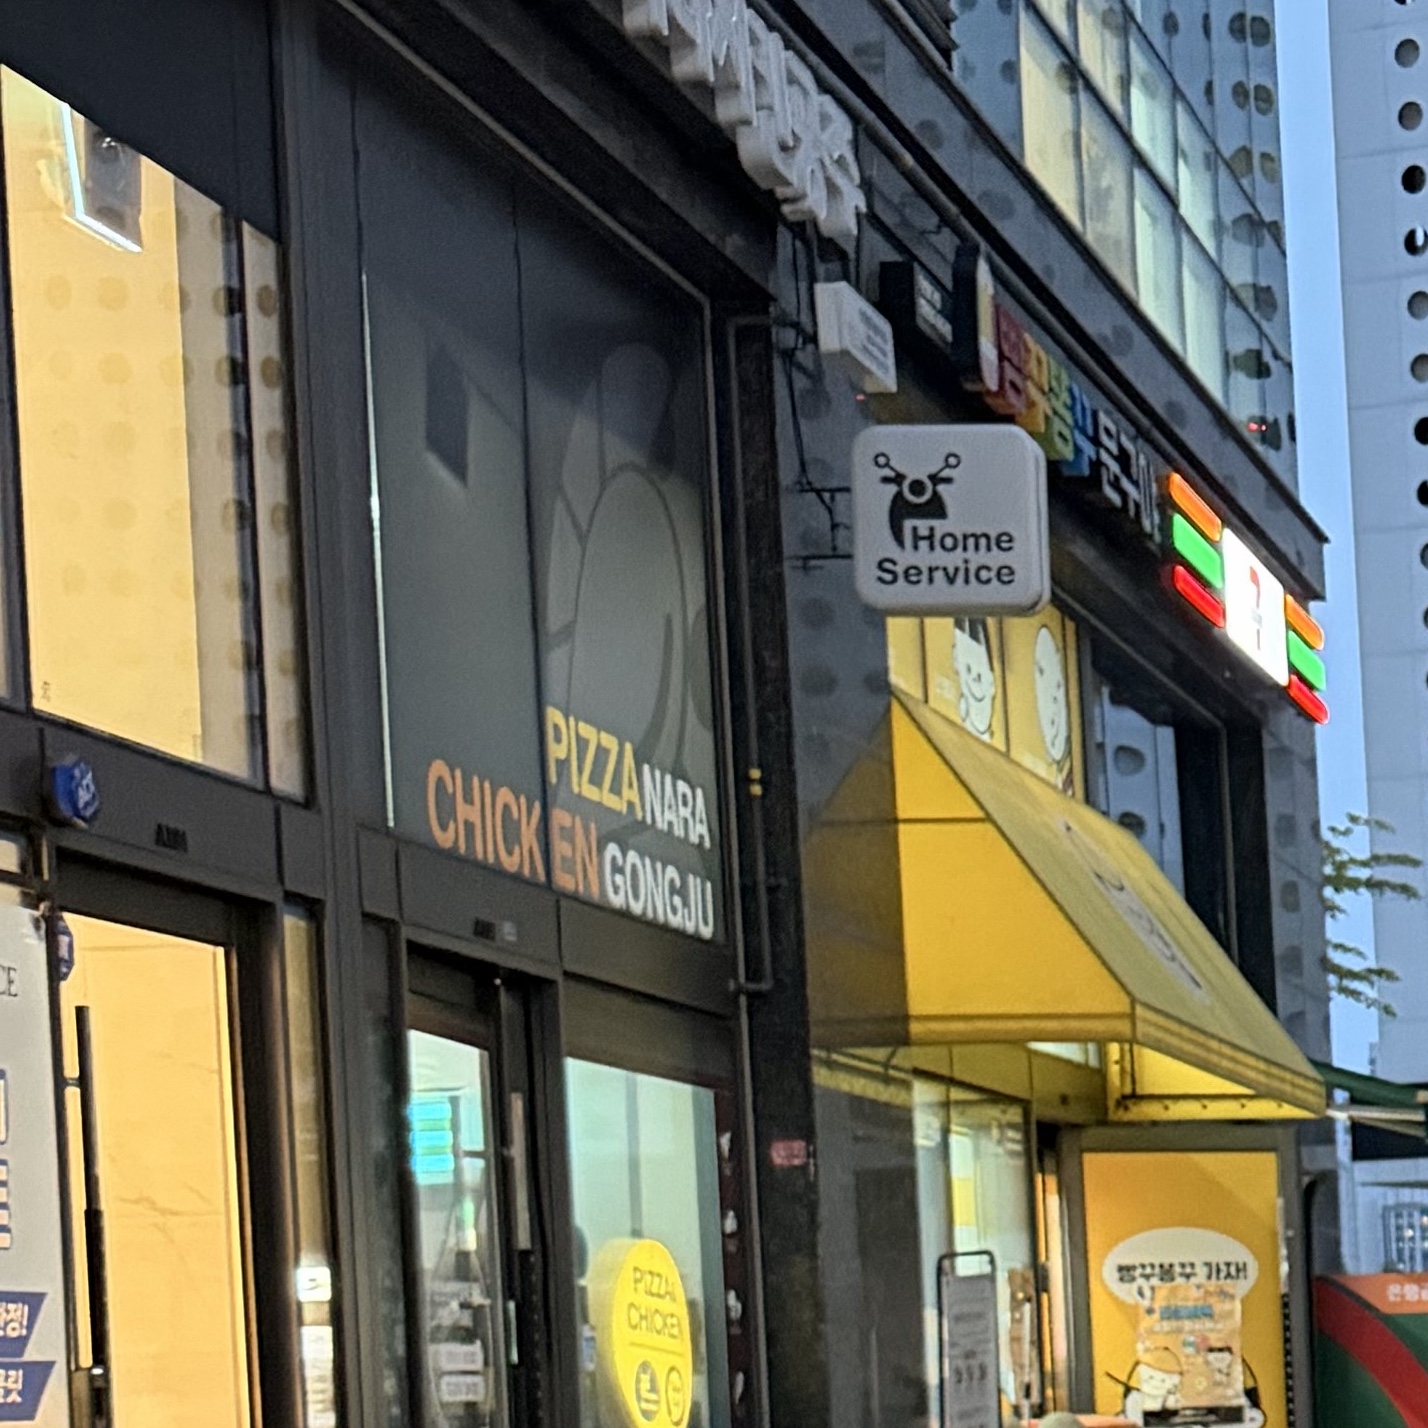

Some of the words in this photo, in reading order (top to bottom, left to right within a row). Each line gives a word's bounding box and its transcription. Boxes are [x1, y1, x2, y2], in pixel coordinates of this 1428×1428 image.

[875, 557, 1017, 587] Service
[910, 525, 1015, 554] Home
[545, 704, 644, 822] PIZZA
[641, 762, 712, 850] NARA
[426, 758, 600, 898] CHICKEN
[603, 841, 715, 940] GONGJU
